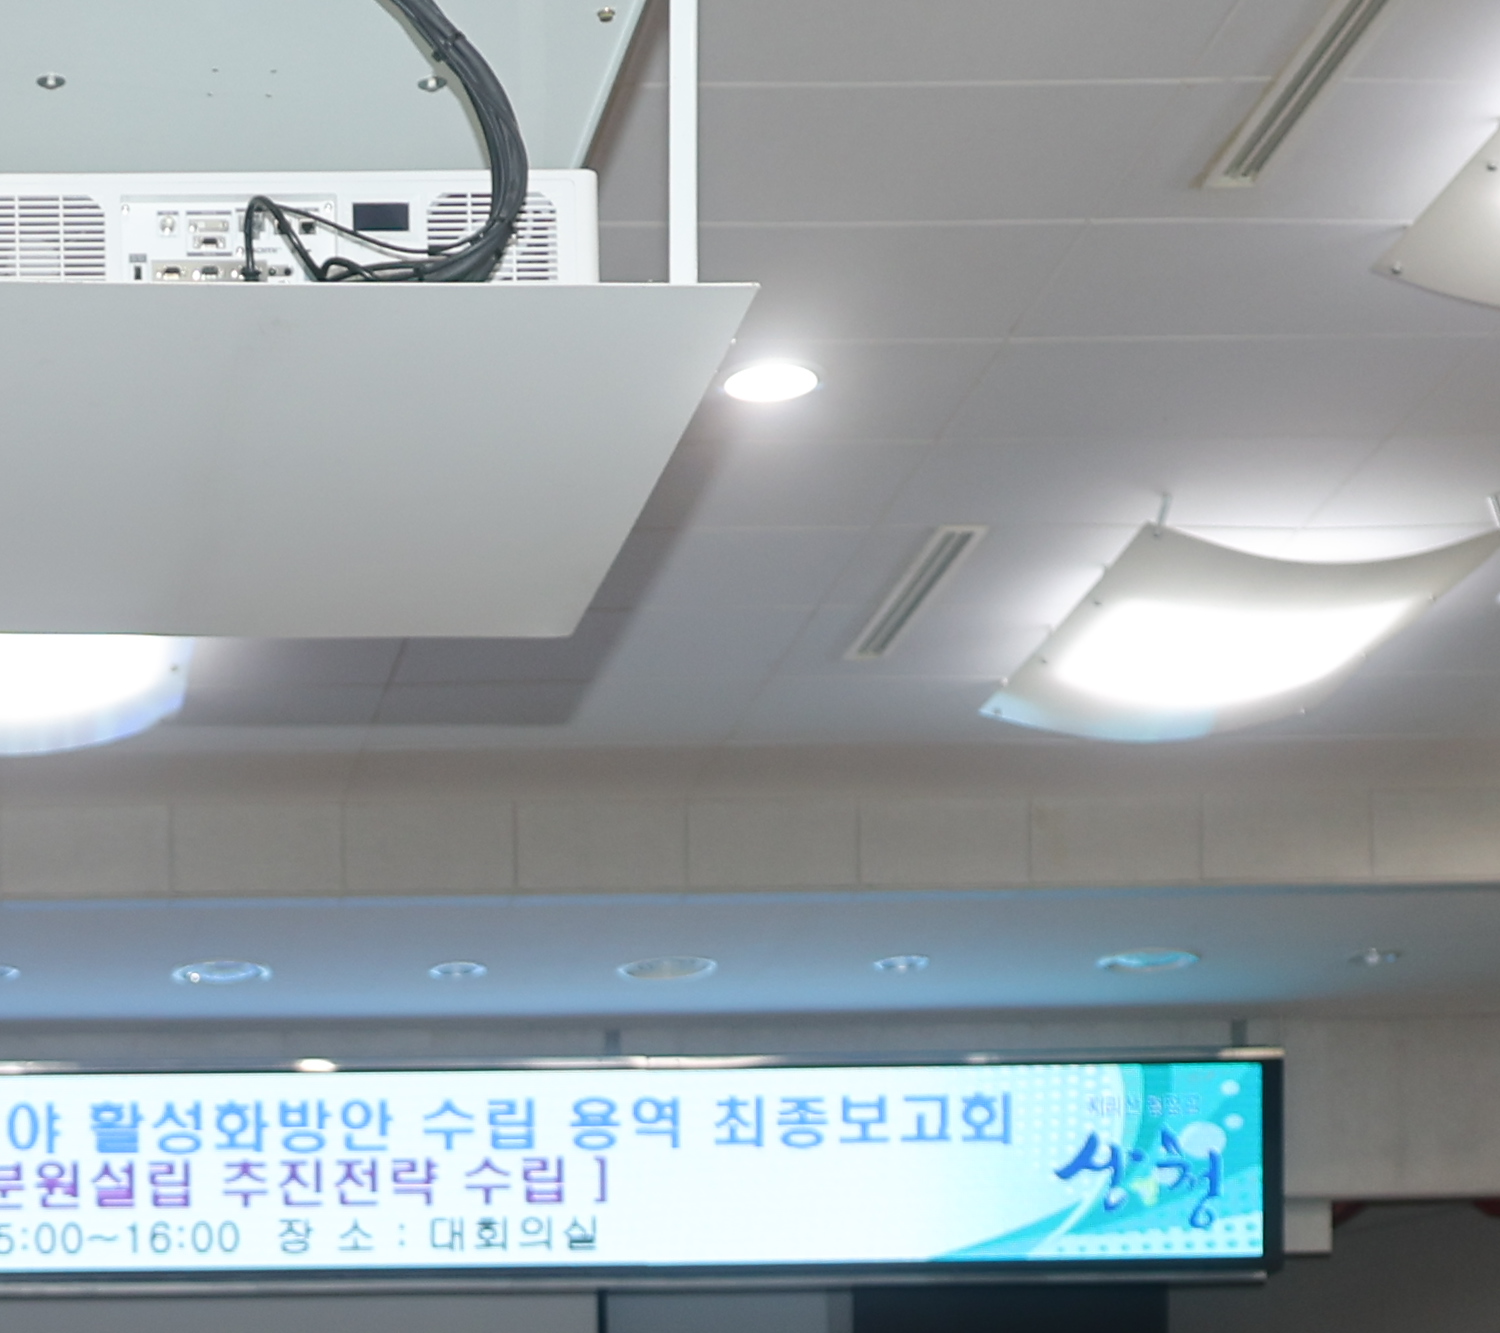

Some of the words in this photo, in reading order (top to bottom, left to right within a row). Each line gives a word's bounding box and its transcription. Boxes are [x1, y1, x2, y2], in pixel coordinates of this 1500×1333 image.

[90, 1098, 393, 1155] 활성화방안
[423, 1097, 536, 1151] 수립
[570, 1096, 681, 1150] 용역
[714, 1092, 1013, 1149] 최종보고회
[222, 1157, 439, 1208] 추진전략
[464, 1156, 566, 1205] 수립
[429, 1215, 598, 1251] 대회의실
